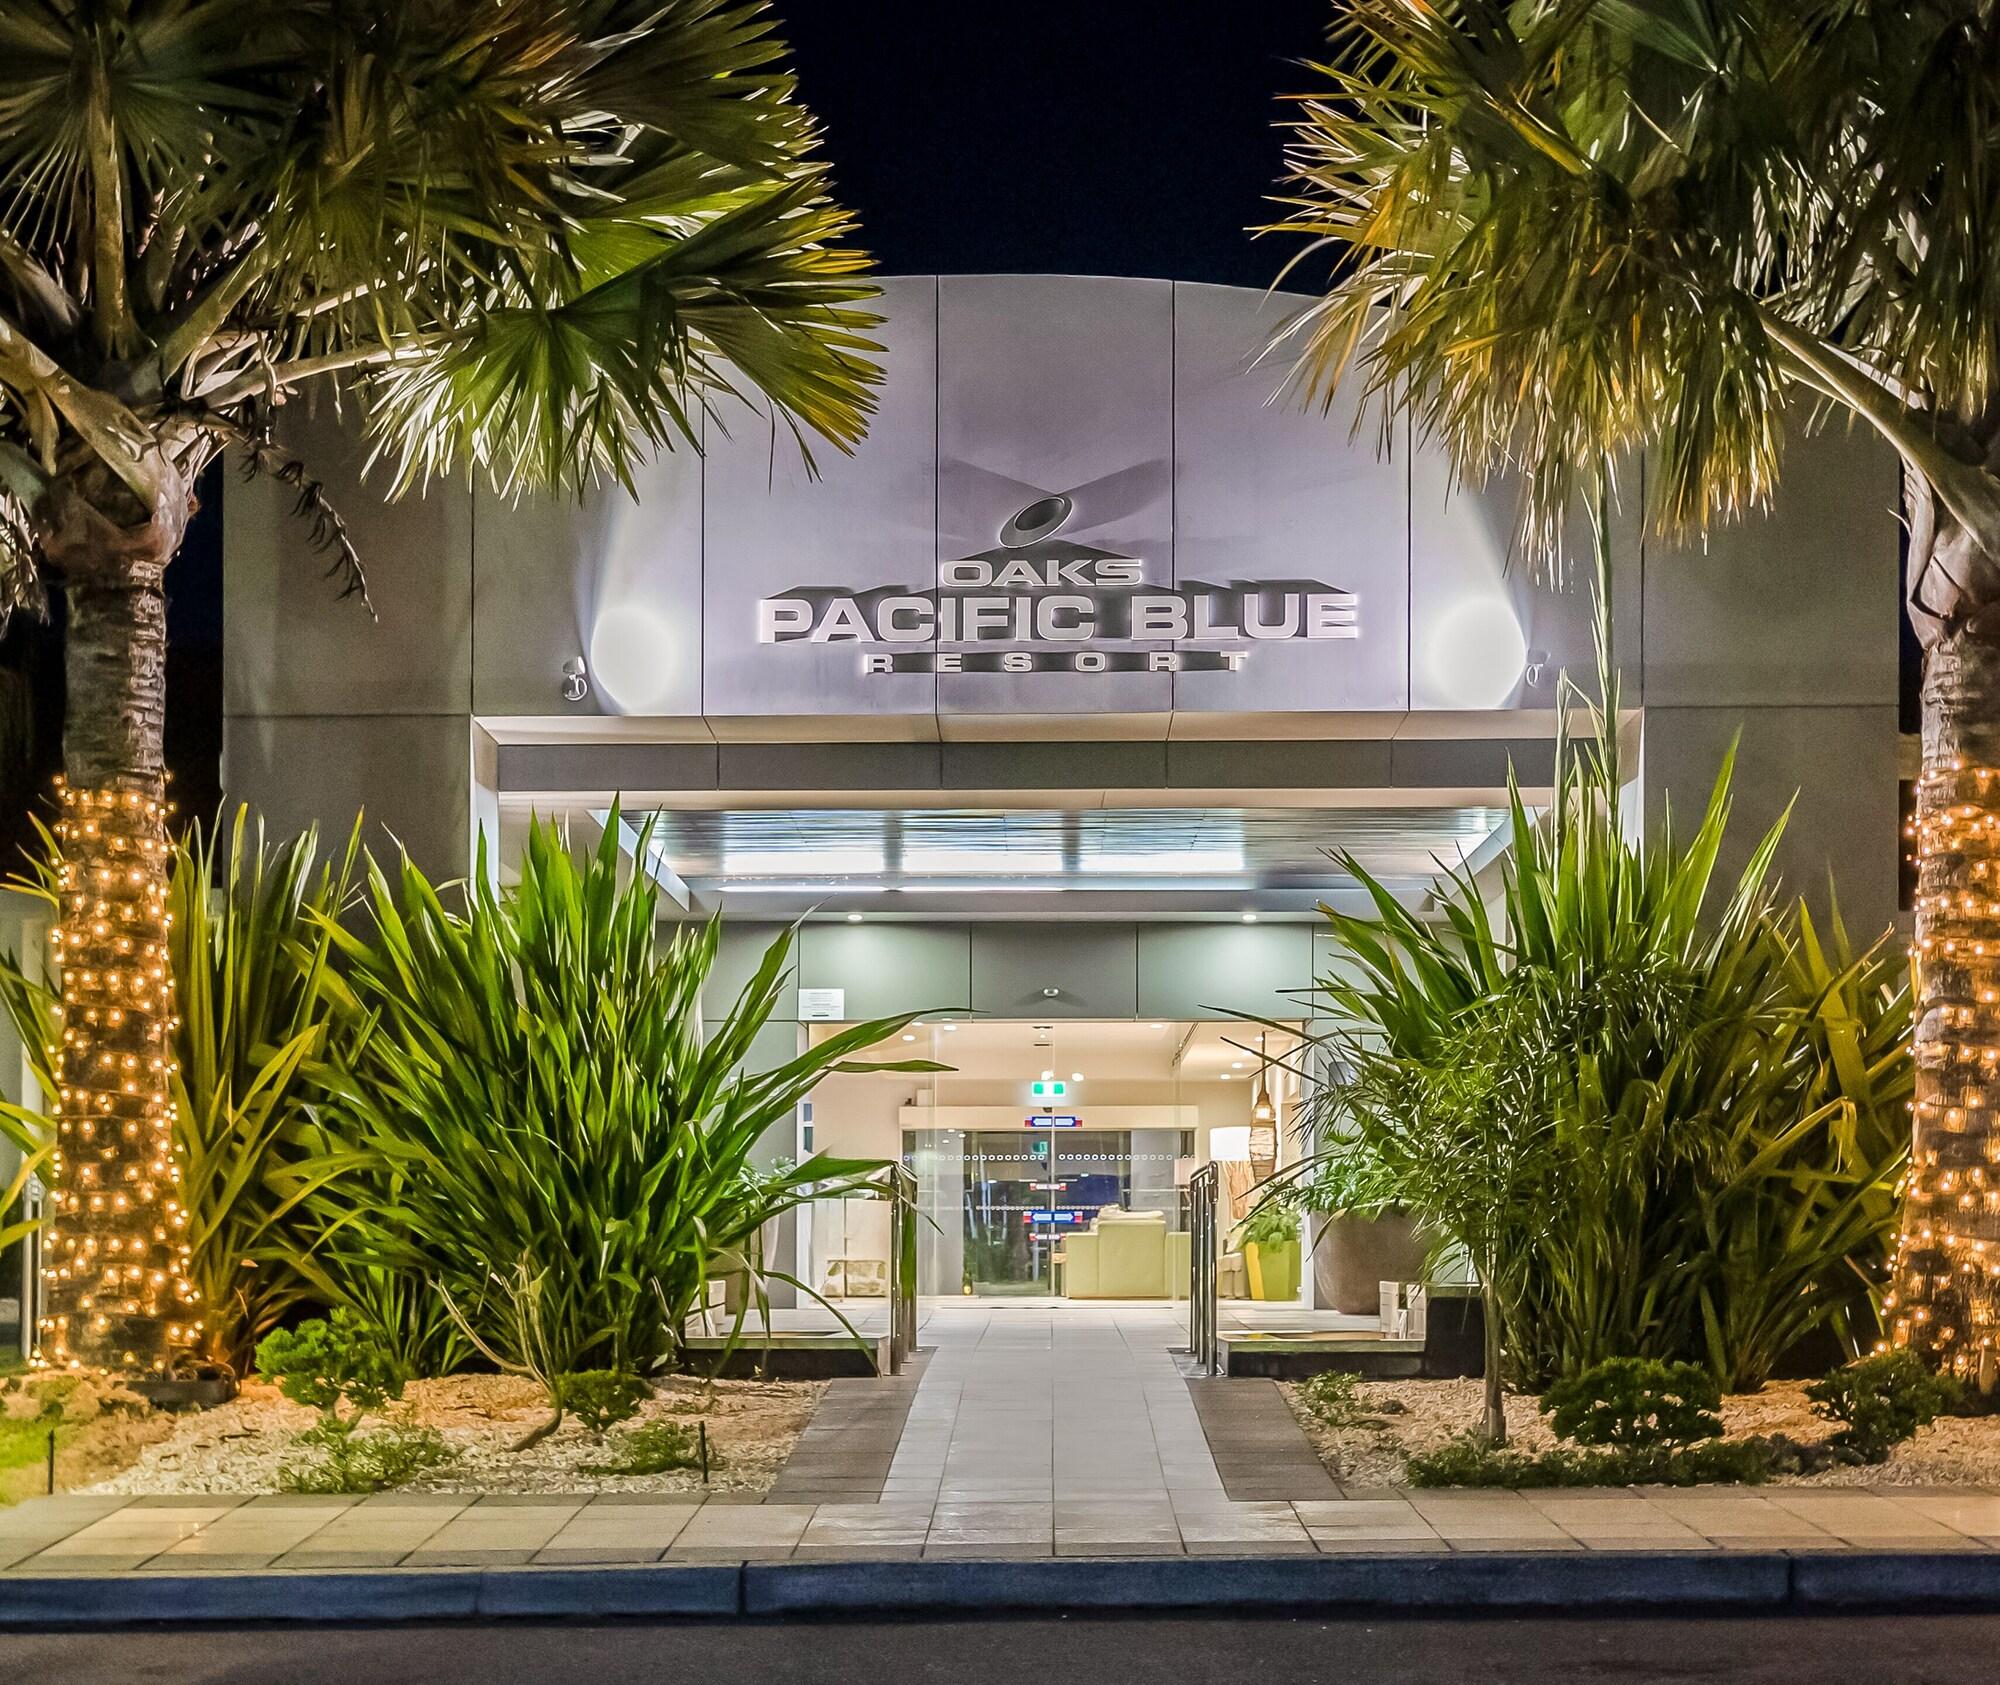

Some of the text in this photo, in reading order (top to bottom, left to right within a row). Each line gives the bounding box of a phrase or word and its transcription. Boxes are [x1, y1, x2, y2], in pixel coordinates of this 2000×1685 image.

[942, 560, 1142, 587] OAKS
[760, 593, 1358, 643] PACIFIC BLUE
[866, 652, 1247, 674] RESORT
